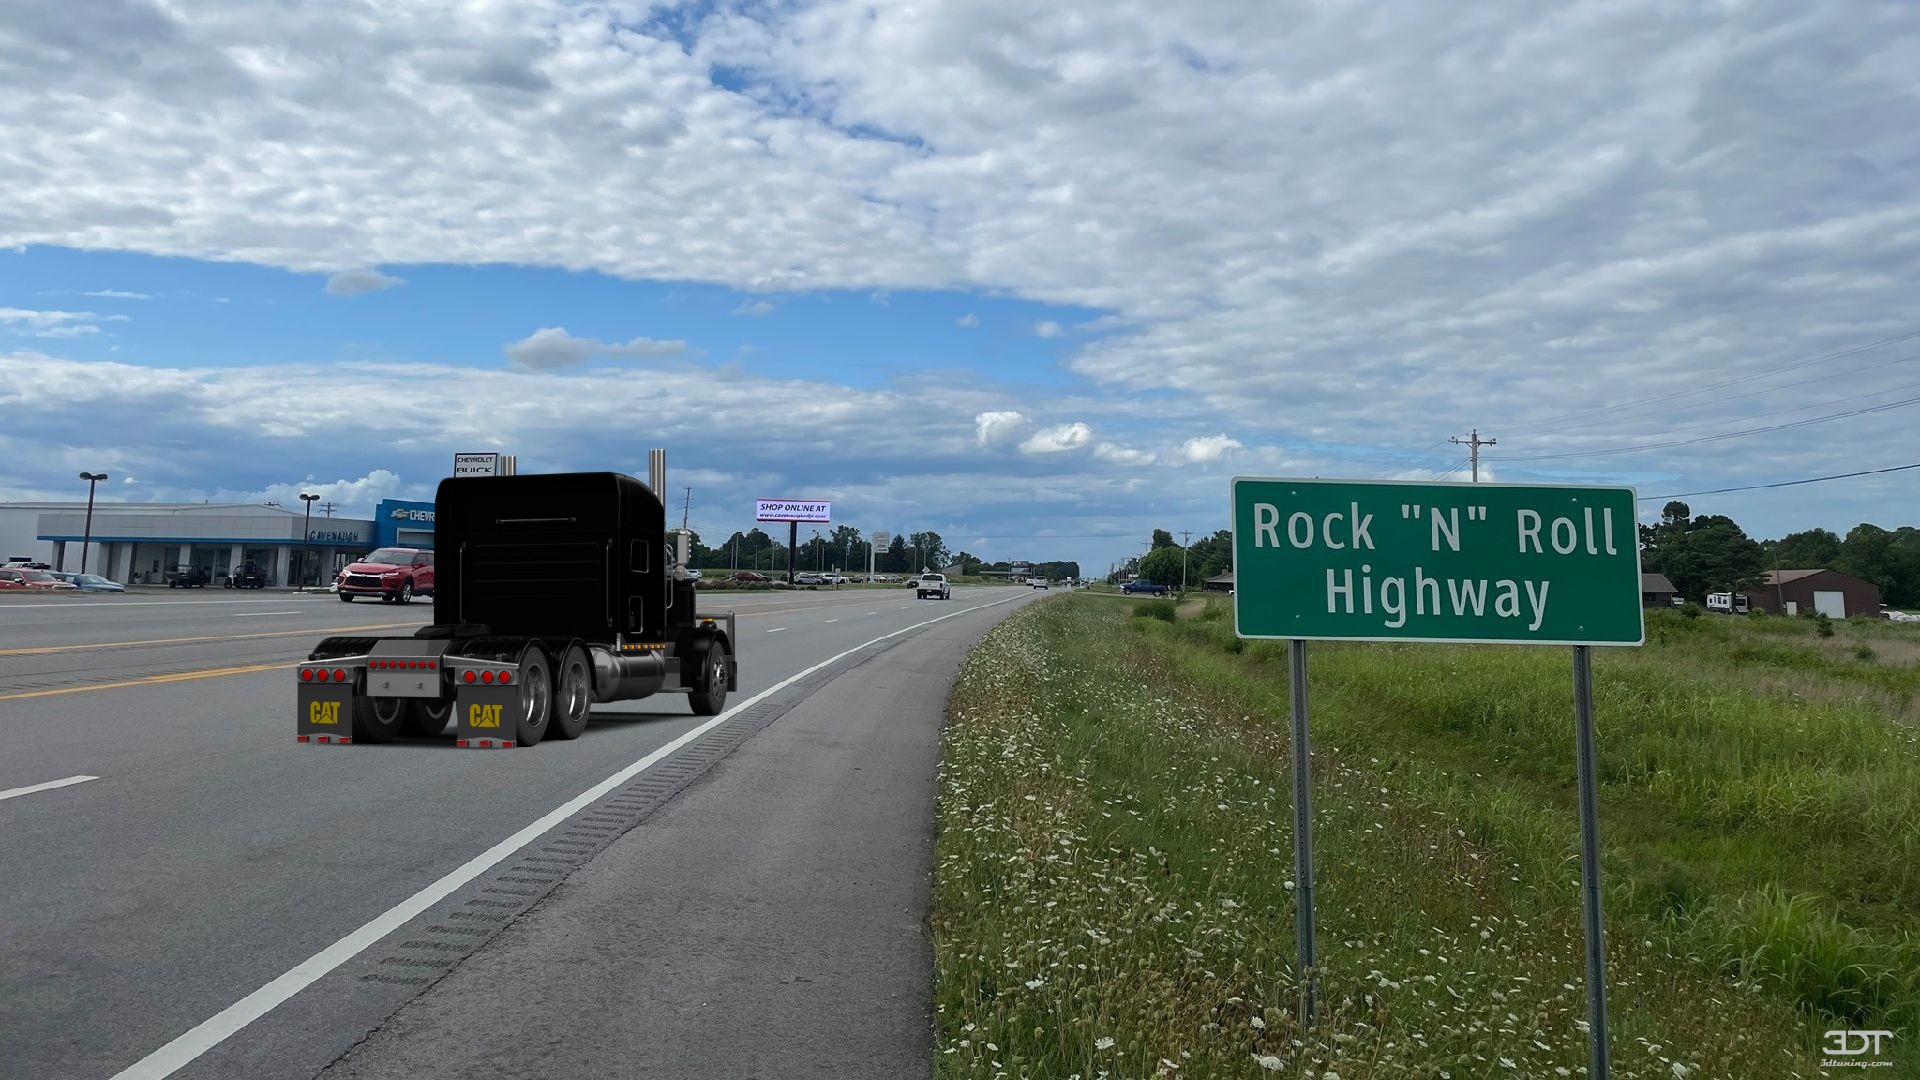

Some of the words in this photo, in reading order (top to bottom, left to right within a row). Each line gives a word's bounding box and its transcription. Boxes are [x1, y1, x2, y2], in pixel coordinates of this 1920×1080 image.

[760, 503, 784, 511] SHOP
[785, 504, 815, 512] ONLINE
[309, 530, 359, 542] CAVENAUGH
[1253, 502, 1376, 550] Rock
[1401, 504, 1487, 552] "N"
[1517, 507, 1617, 555] Roll
[1326, 564, 1550, 631] Highway
[310, 701, 341, 724] CAT
[469, 703, 503, 728] CAT
